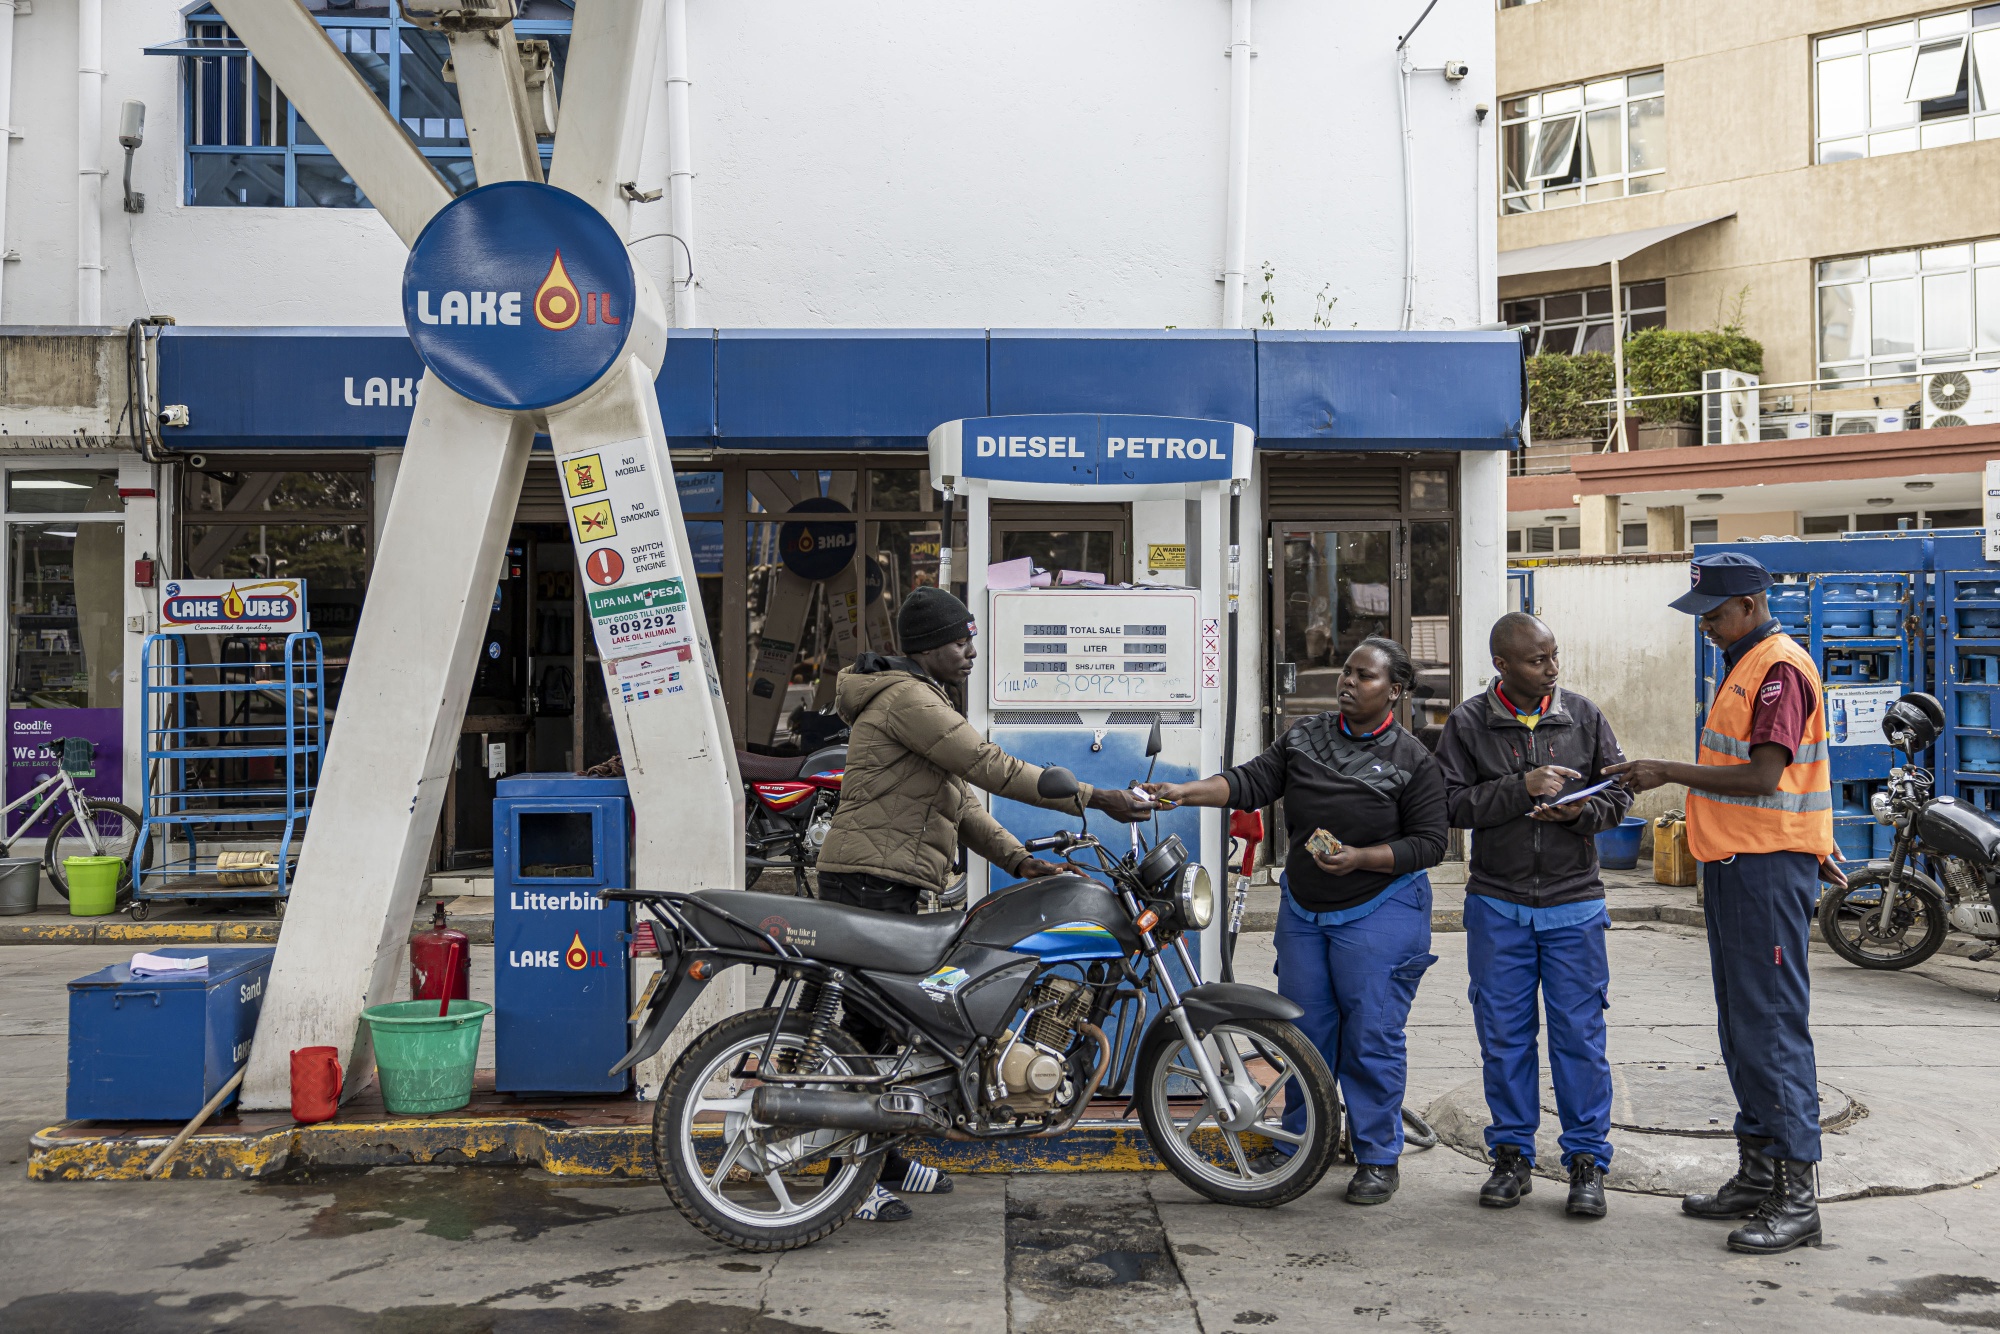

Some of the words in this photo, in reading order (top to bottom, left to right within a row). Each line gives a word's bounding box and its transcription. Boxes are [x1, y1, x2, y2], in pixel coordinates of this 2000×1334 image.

[417, 290, 521, 326] LAKE
[976, 436, 1085, 458] DIESEL
[1107, 437, 1226, 460] PETROL
[621, 456, 635, 466] NO
[614, 464, 646, 477] MOBILE
[631, 502, 645, 511] NO
[620, 508, 660, 524] SMOKING
[630, 541, 664, 554] SWITCH
[632, 554, 648, 564] OFF
[649, 550, 666, 560] THE
[635, 560, 667, 573] ENGINE
[171, 601, 218, 617] LAKE
[228, 597, 289, 617] LUBES
[594, 598, 616, 609] LIPA
[617, 595, 632, 605] NA
[598, 618, 613, 626] BUY
[613, 612, 638, 623] GOODS
[639, 610, 655, 619] TILL
[655, 604, 687, 615] NUMBER
[194, 623, 234, 631] Committed
[245, 623, 272, 632] quality
[609, 614, 676, 636] 809292
[1069, 626, 1098, 634] TOTAL
[1099, 626, 1121, 634] SALE
[612, 635, 631, 645] LAKE
[631, 633, 643, 641] OIL
[644, 627, 677, 639] KILIMANI
[1083, 645, 1108, 653] LITER
[666, 684, 684, 694] VISA
[1053, 674, 1147, 696] 809292
[13, 720, 52, 731] Goodlife
[12, 746, 36, 759] We
[510, 891, 604, 911] Litterbin
[786, 927, 798, 936] You
[798, 928, 811, 938] like
[811, 929, 817, 938] it
[785, 936, 793, 944] We
[794, 937, 810, 946] shape
[509, 950, 559, 968] LAKE
[240, 976, 261, 1004] Sand
